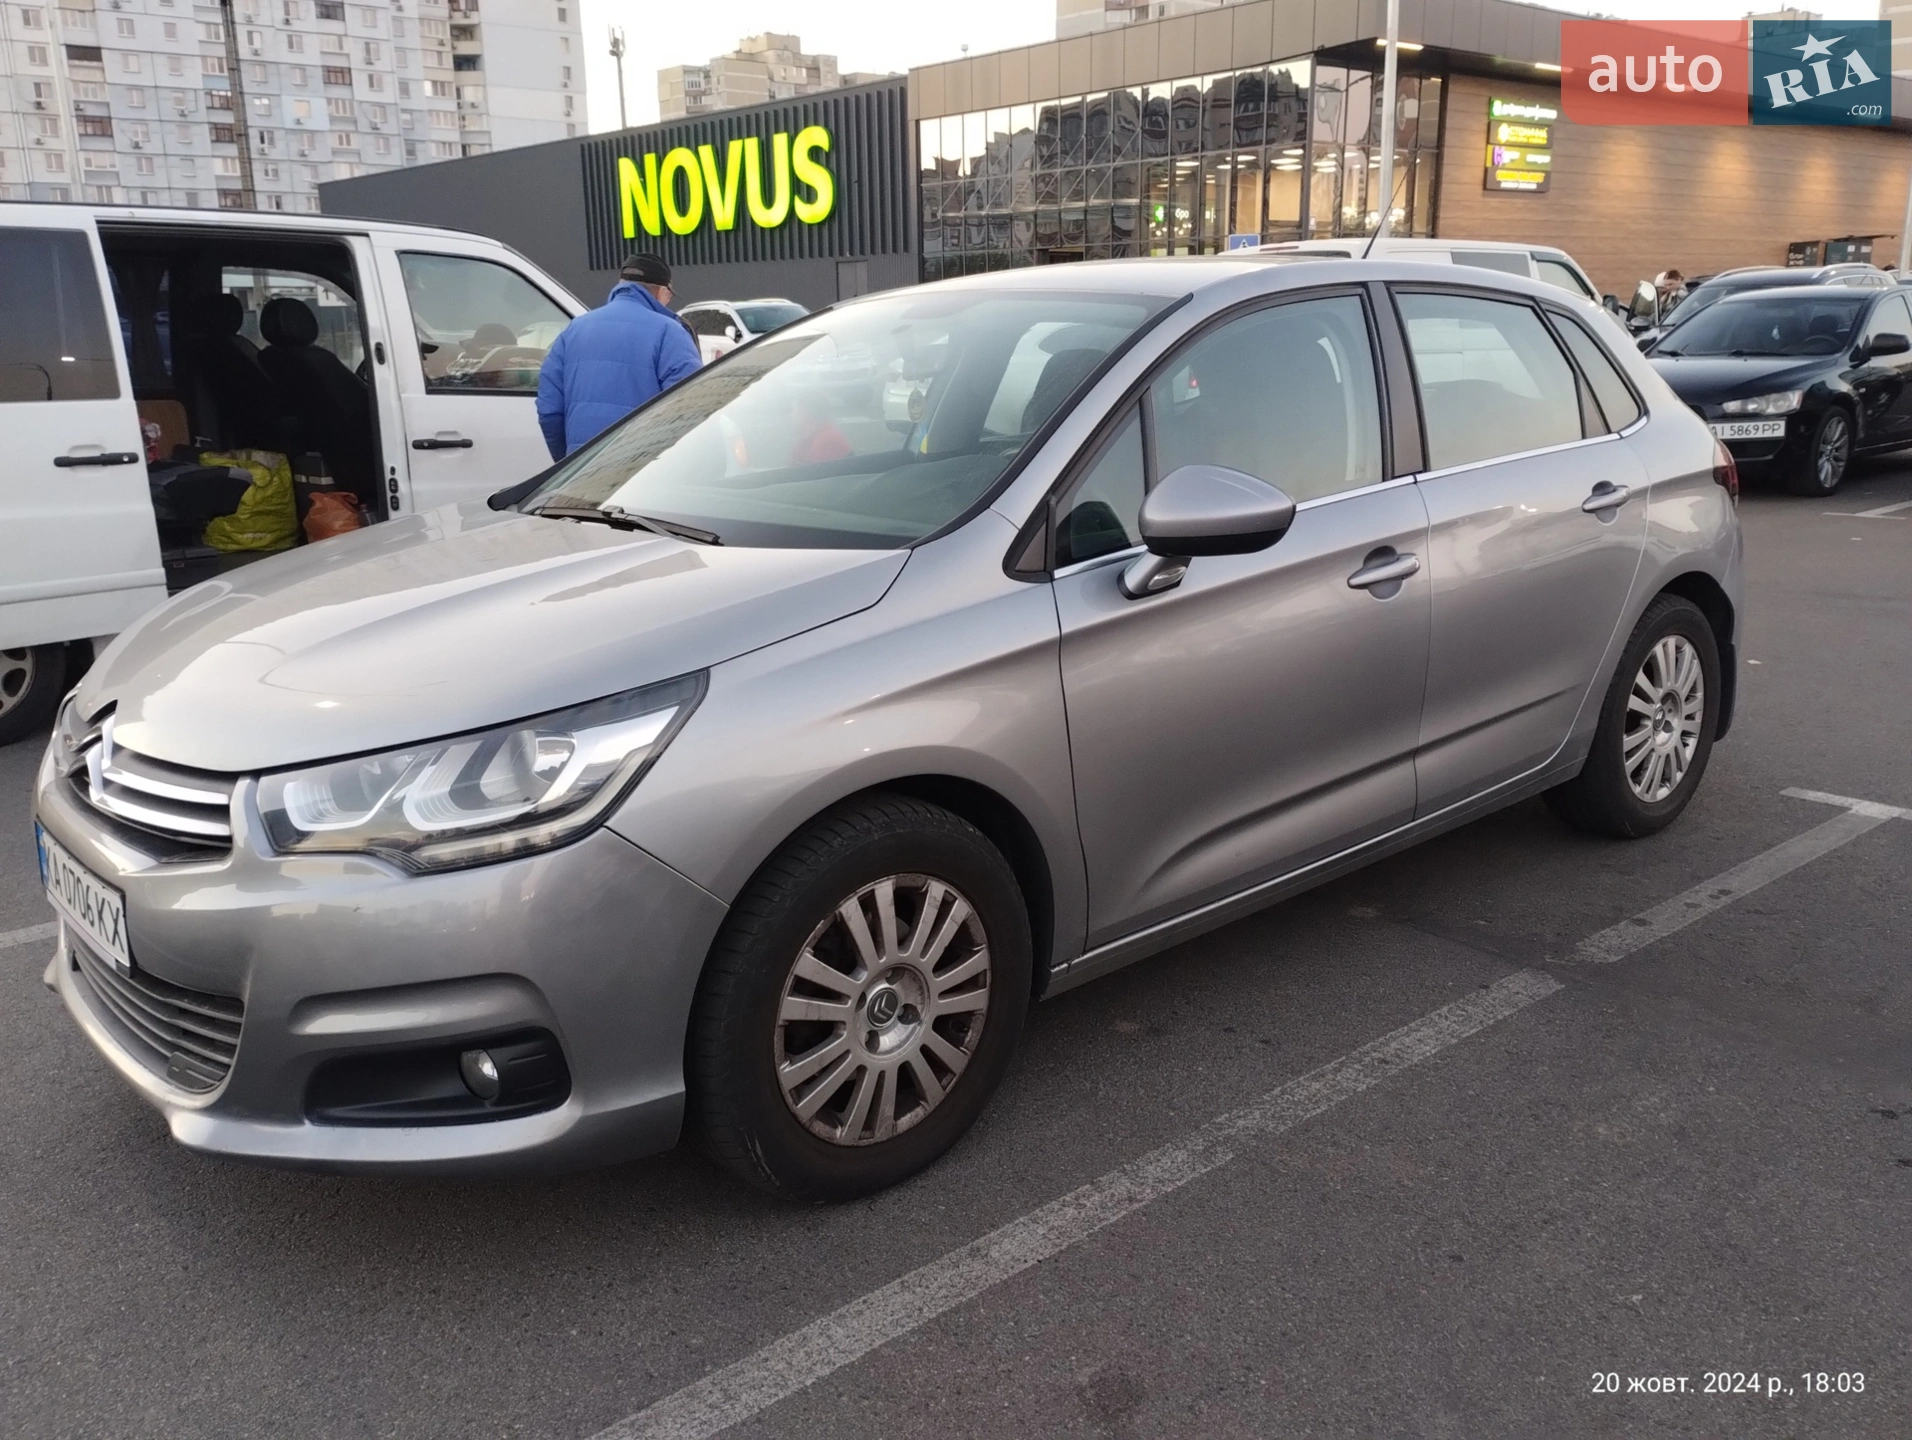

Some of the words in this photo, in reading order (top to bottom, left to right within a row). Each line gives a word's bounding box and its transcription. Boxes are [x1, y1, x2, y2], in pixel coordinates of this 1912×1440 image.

[618, 125, 835, 239] NOVUS
[1729, 424, 1760, 437] 5869
[1761, 423, 1781, 435] PP
[62, 862, 95, 928] 0706
[95, 890, 125, 954] KX
